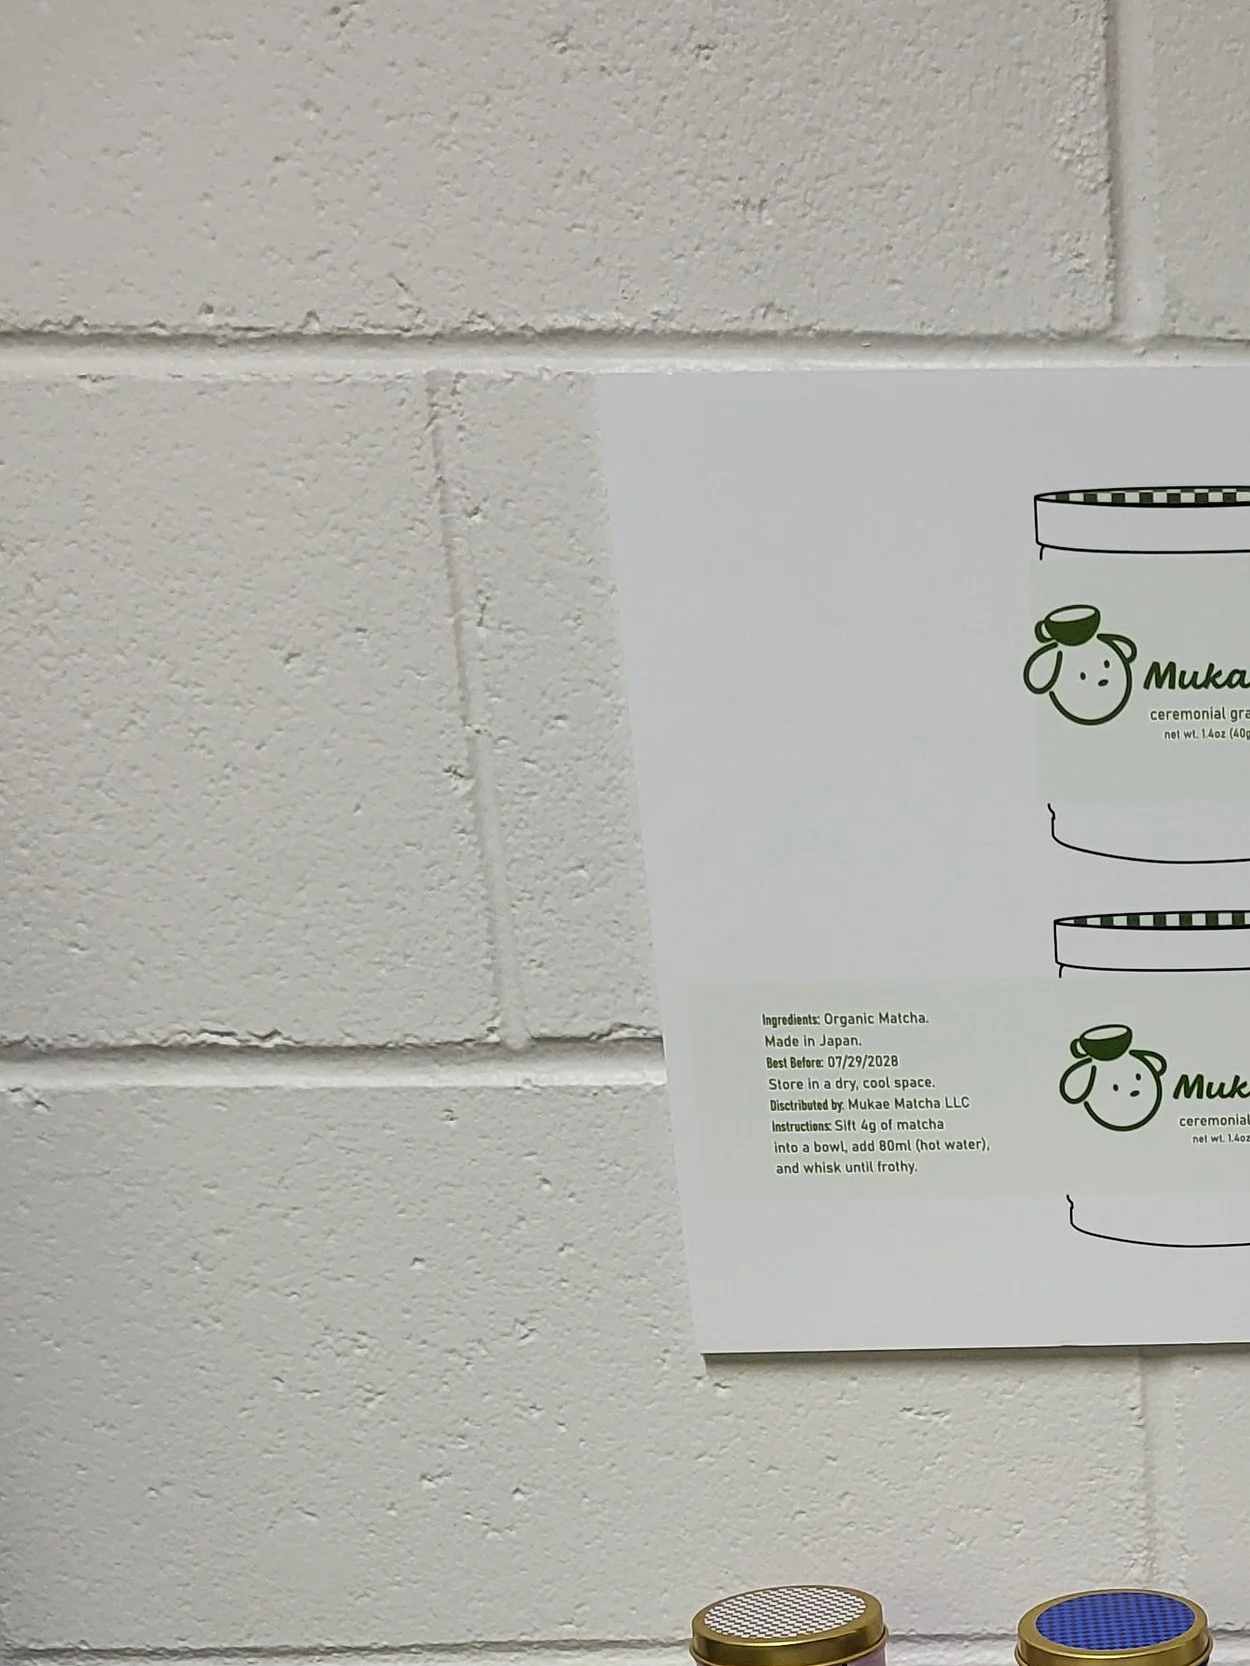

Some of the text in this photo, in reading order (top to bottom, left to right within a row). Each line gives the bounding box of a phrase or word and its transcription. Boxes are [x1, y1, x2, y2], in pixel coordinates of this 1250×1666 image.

[1150, 706, 1226, 720] ceremonial
[1165, 729, 1180, 739] net
[1184, 729, 1198, 739] wt.
[1202, 728, 1225, 738] 1.4oz
[762, 1011, 929, 1028] Ingredients: Organic Matcha.
[765, 1034, 862, 1049] Made in Japan.
[766, 1054, 898, 1069] Best Before: 07/29/2028
[769, 1076, 935, 1091] Store in a dry, cool space.
[848, 1098, 890, 1110] Mukae
[894, 1097, 941, 1109] Matcha
[945, 1096, 970, 1108] LLC
[772, 1118, 944, 1132] Instructions: Sift 4g of matcha
[1180, 1113, 1250, 1126] ceremonial
[774, 1137, 990, 1153] into a bowl, add 80ml (hot water),
[1193, 1134, 1207, 1143] net
[1211, 1134, 1224, 1142] wt.
[1228, 1133, 1250, 1142] 1.4oz
[776, 1160, 917, 1174] and whisk until frothy.
